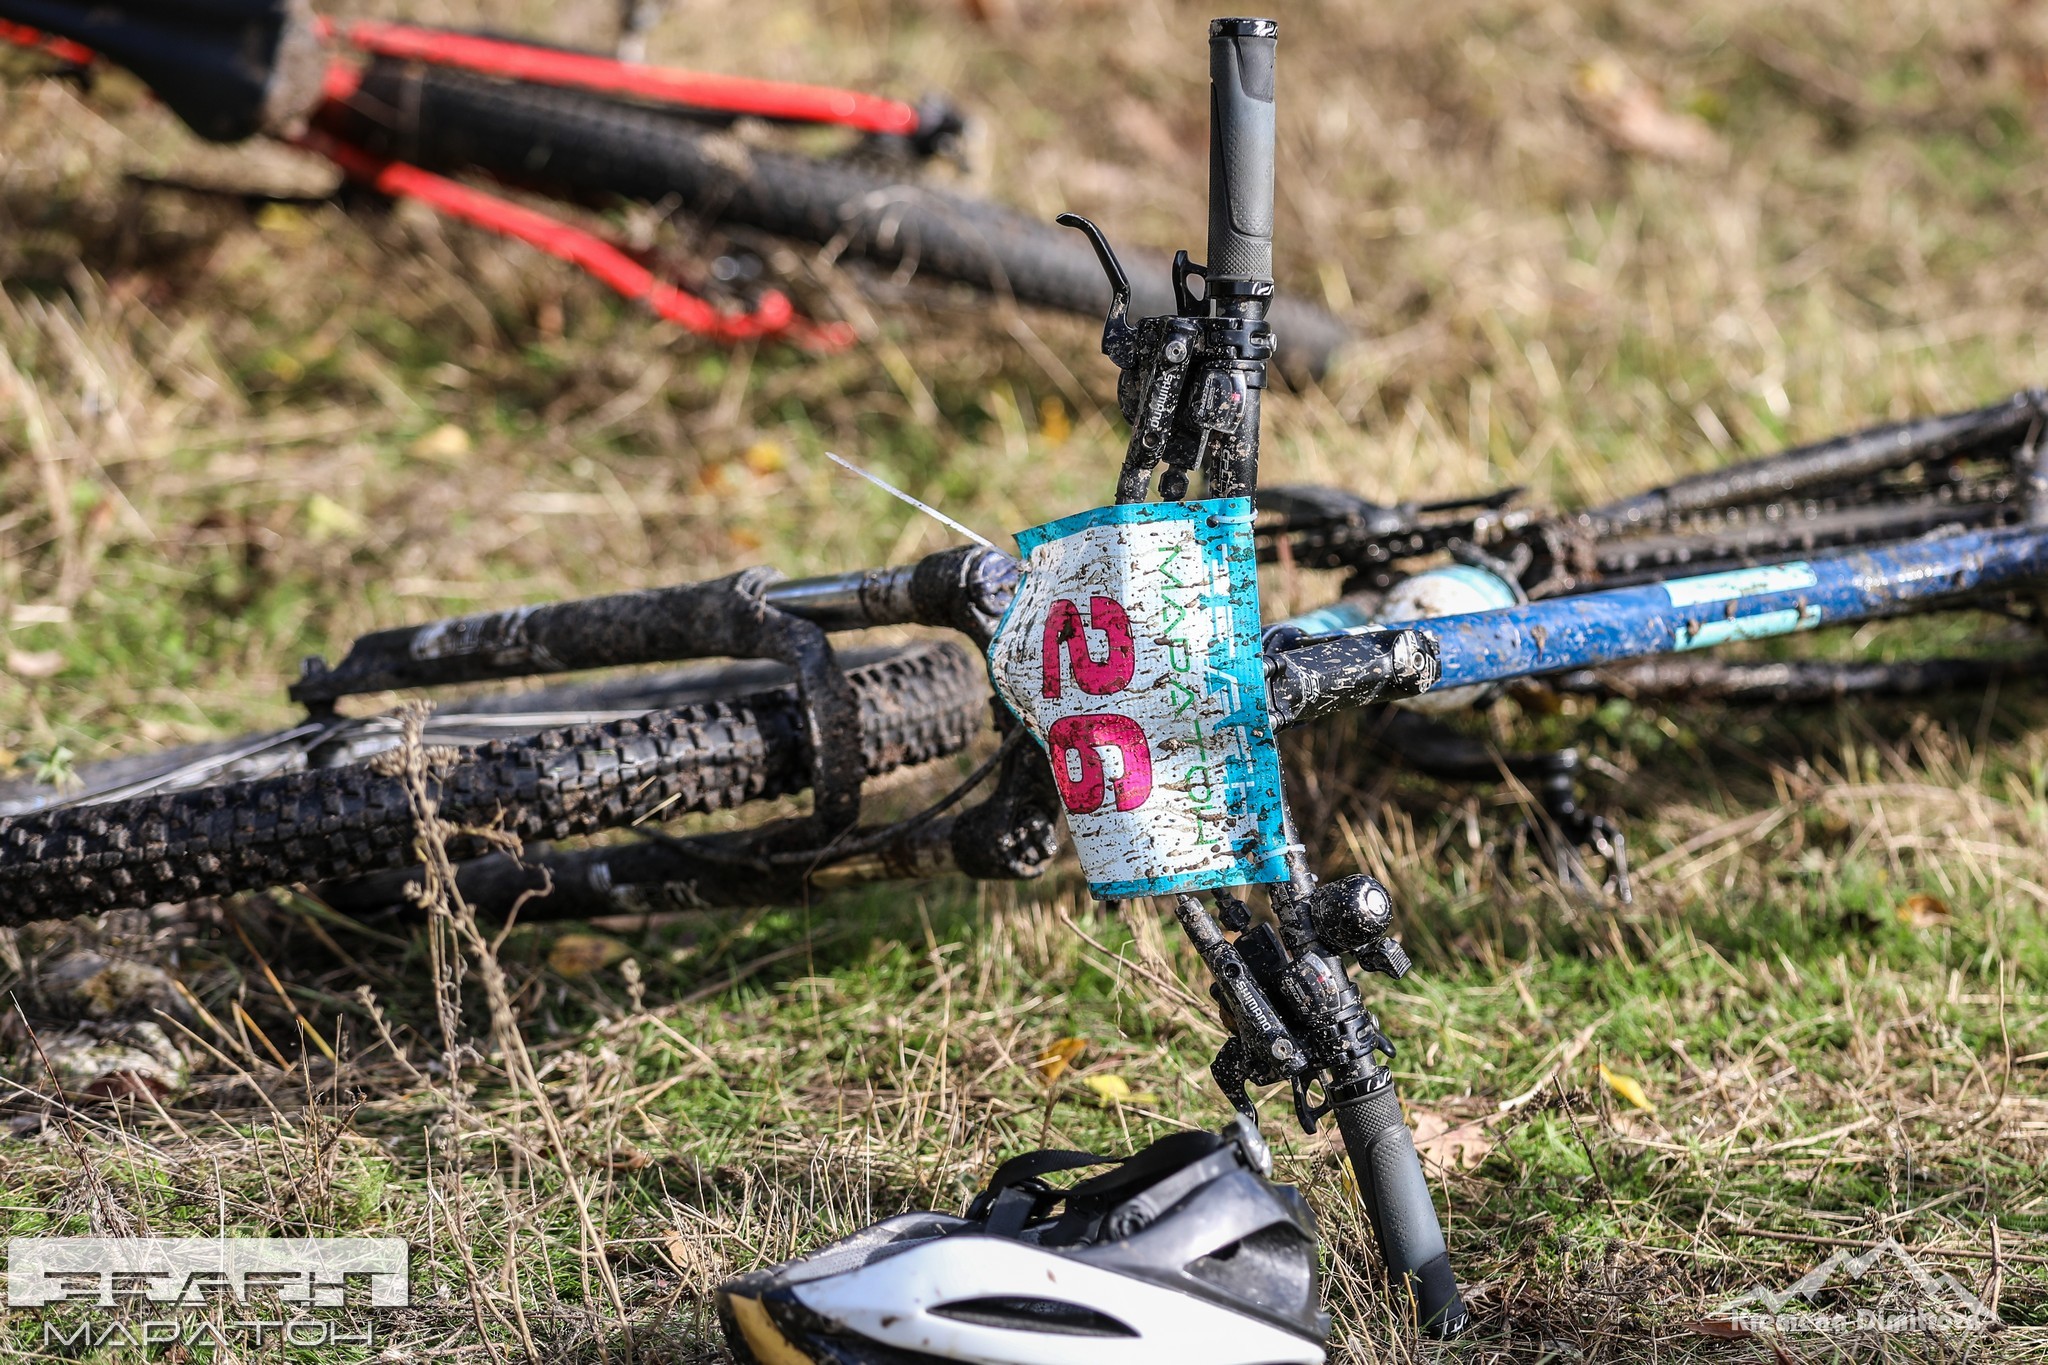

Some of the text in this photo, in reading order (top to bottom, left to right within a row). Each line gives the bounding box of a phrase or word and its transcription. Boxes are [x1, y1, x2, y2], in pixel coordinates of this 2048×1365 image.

[1150, 373, 1175, 429] SHIMANO
[1042, 595, 1153, 814] 26
[1236, 980, 1272, 1031] SHIMANO
